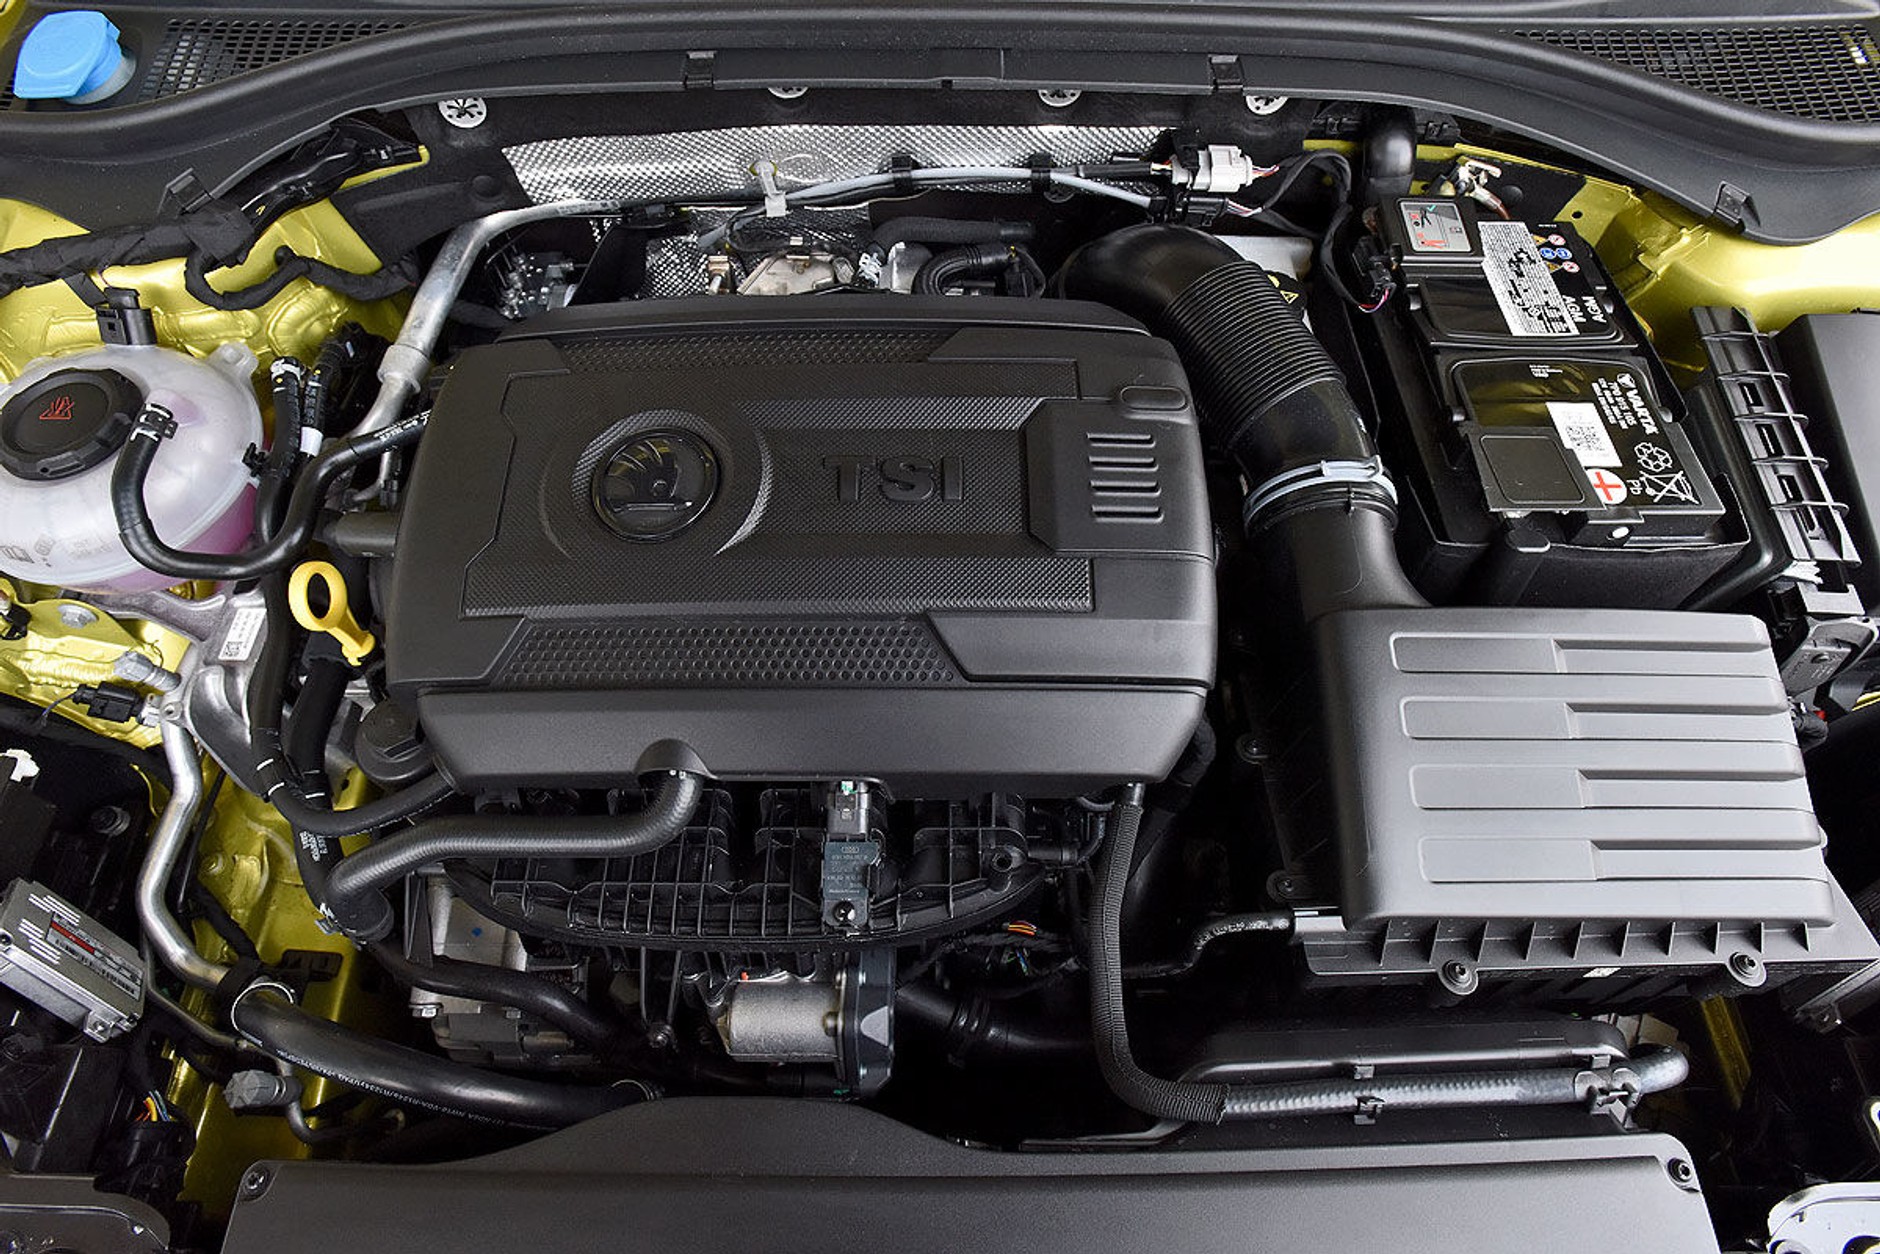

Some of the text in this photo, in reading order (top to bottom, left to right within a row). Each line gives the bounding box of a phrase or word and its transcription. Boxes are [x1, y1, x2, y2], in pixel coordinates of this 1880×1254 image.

[1562, 295, 1587, 322] AGM
[1581, 296, 1607, 323] AGM
[1626, 389, 1659, 435] VARTA
[823, 455, 964, 501] TSI
[1626, 480, 1642, 495] Pb
